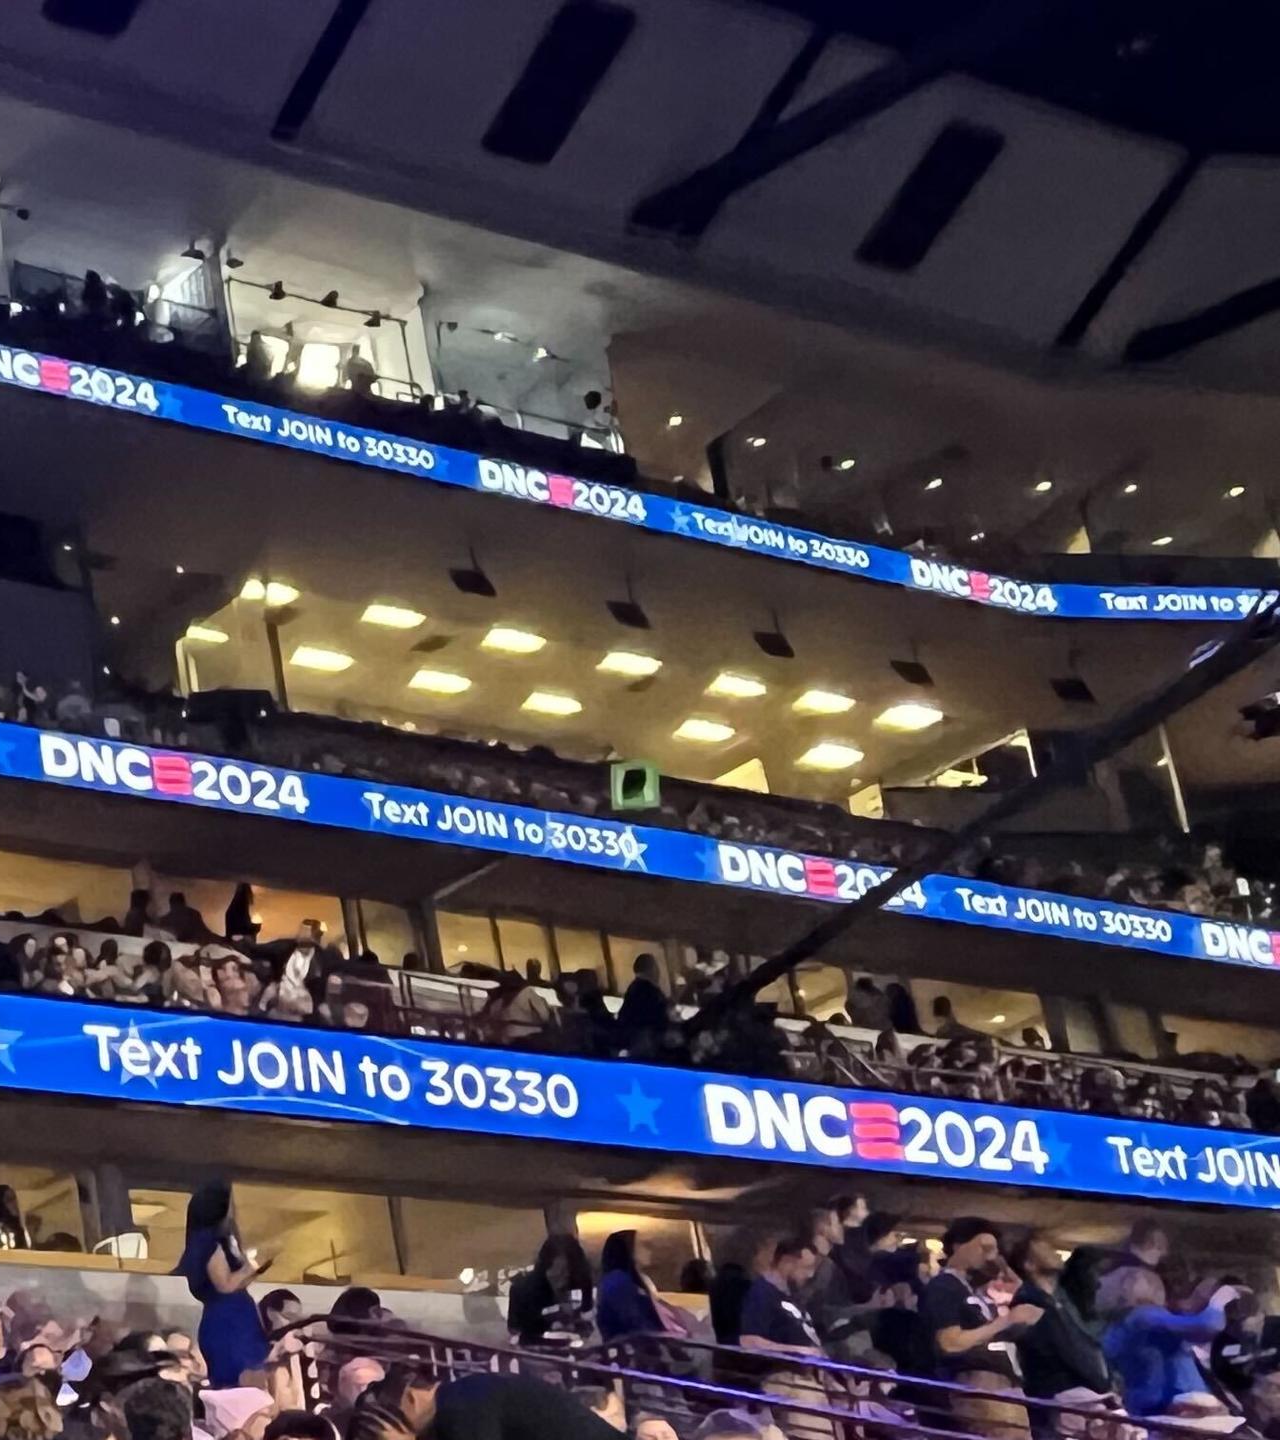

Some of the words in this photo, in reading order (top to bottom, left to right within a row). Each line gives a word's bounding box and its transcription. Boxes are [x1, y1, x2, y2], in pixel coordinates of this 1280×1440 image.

[69, 369, 158, 411] 2024
[222, 405, 270, 432] Text
[278, 419, 332, 445] JOIN
[338, 432, 360, 452] to
[365, 437, 434, 468] 30330
[479, 460, 550, 502] DNC
[571, 481, 646, 520] 2024
[40, 734, 153, 790] DNC
[191, 761, 309, 813] 2024
[364, 793, 428, 826] Text
[438, 806, 507, 838] JOIN
[514, 819, 543, 843] to
[547, 822, 637, 860] 30330
[718, 844, 807, 892] DNC
[956, 889, 1007, 916] Text
[1014, 898, 1069, 926] JOIN
[1073, 908, 1097, 930] to
[1100, 911, 1171, 941] 30330
[1201, 923, 1275, 966] DNC
[84, 1025, 201, 1079] Text
[218, 1041, 345, 1094] JOIN
[359, 1056, 410, 1100] to
[422, 1061, 578, 1117] 30330
[704, 1084, 849, 1156] DNC
[900, 1113, 1048, 1173] 2024
[1107, 1136, 1187, 1179] Text
[1198, 1148, 1280, 1188] JOIN
